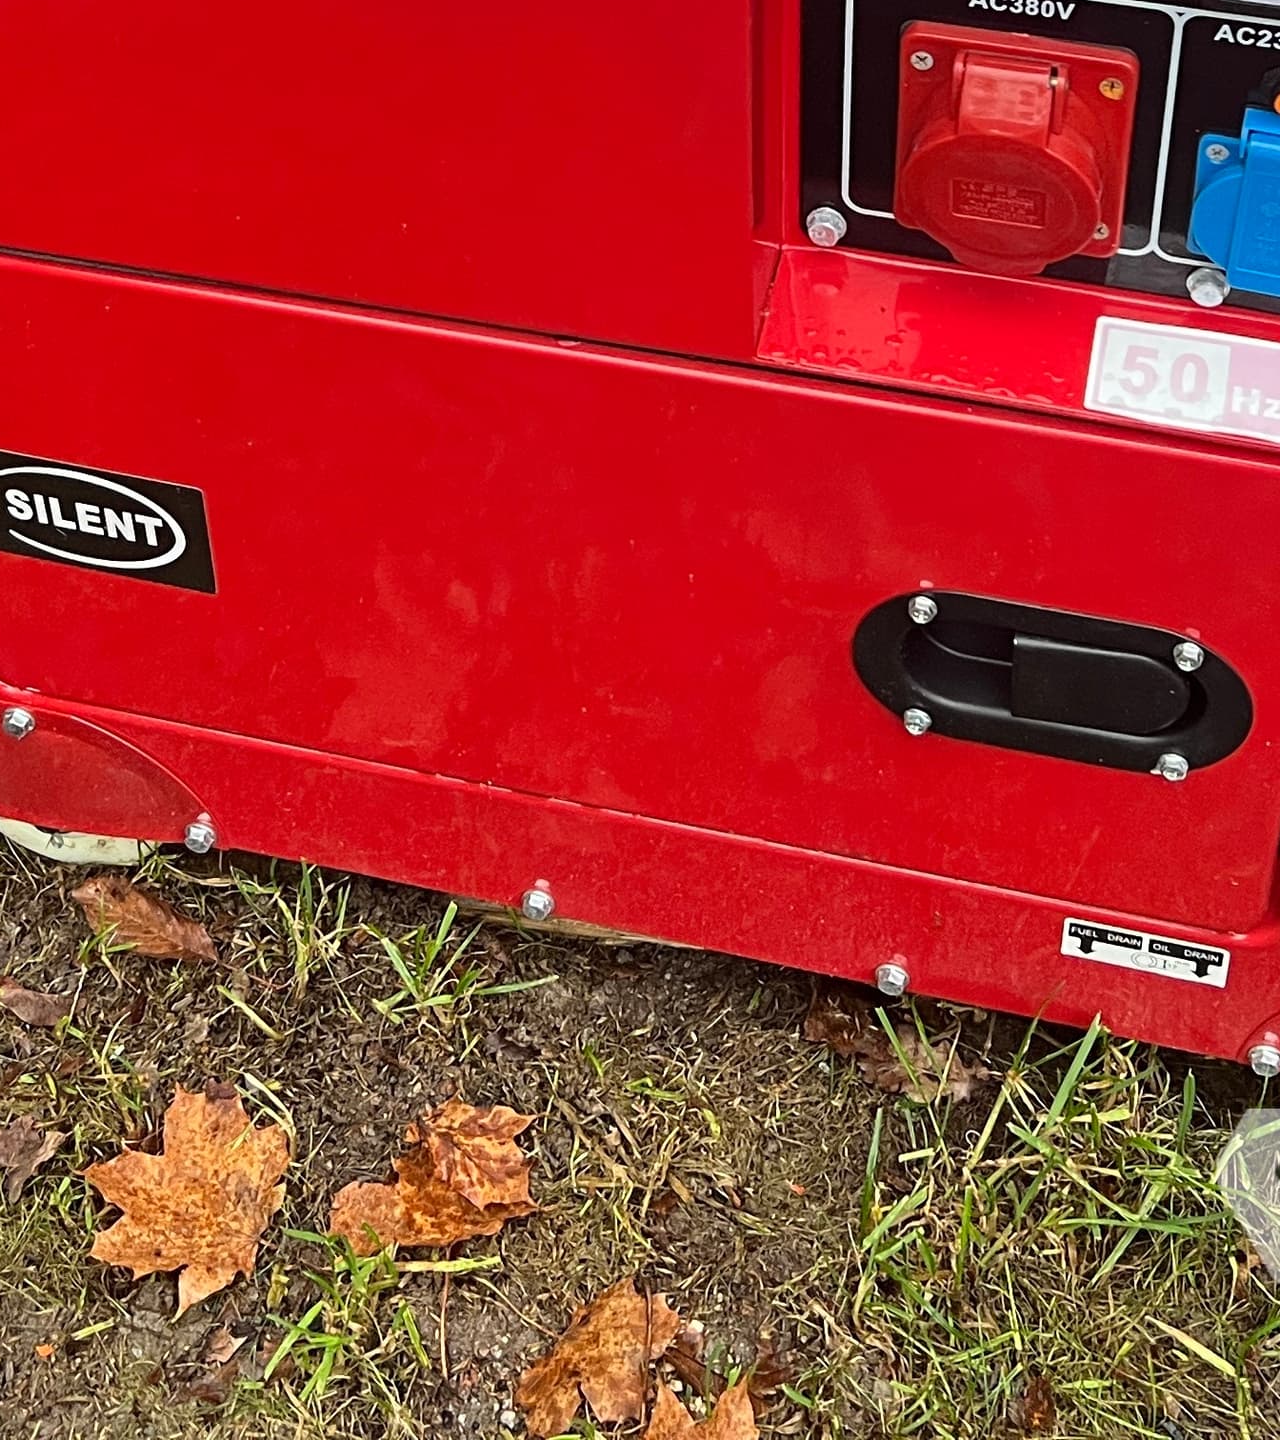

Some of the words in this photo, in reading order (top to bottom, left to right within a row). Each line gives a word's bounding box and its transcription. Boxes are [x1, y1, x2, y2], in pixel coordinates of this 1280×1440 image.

[1118, 344, 1210, 404] 50
[4, 488, 163, 547] SILENT
[1070, 926, 1099, 939] FUEL
[1107, 933, 1141, 947] DRAIN
[1152, 943, 1171, 953] OIL
[1183, 949, 1220, 963] DRAIN
